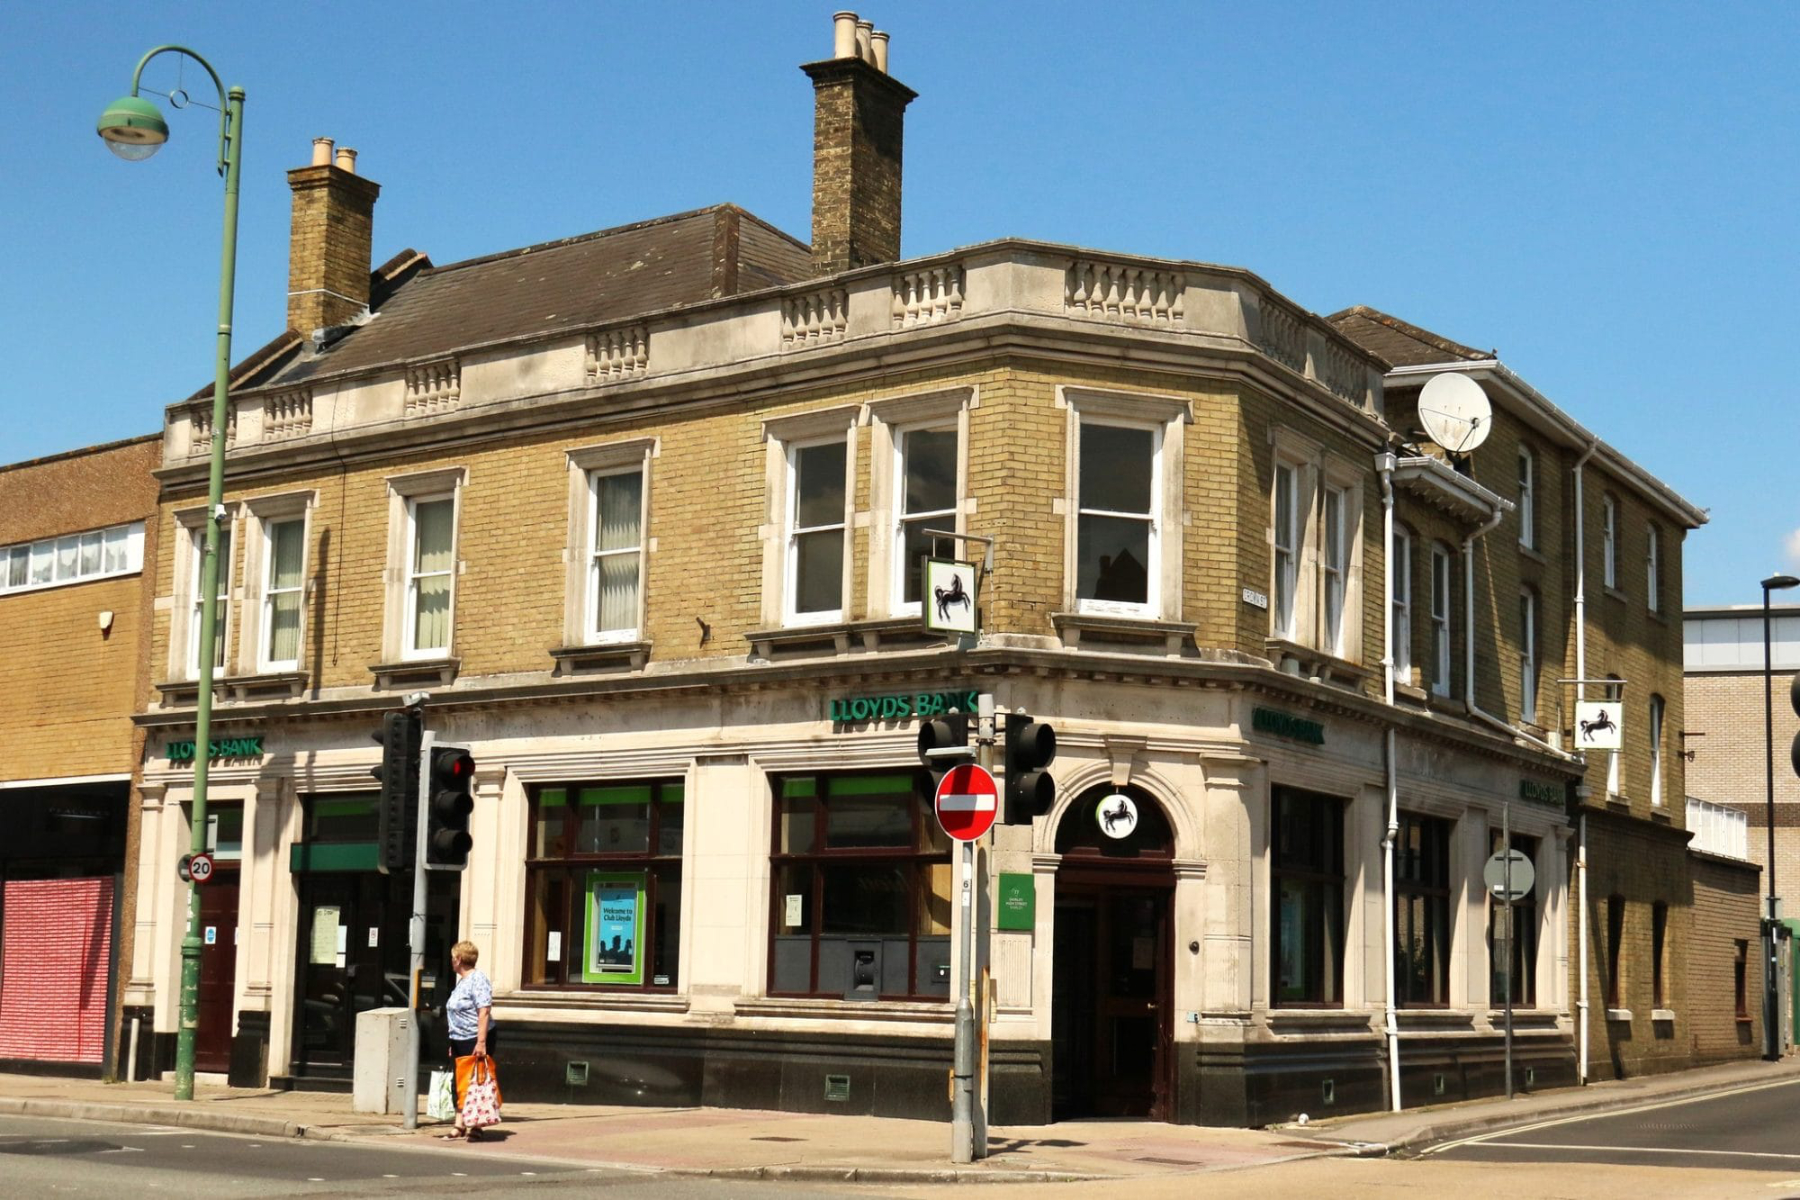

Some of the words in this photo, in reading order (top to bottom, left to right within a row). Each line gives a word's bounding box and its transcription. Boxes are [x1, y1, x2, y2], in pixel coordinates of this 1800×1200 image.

[831, 697, 911, 721] LLOYDS
[166, 742, 218, 759] LLOYS
[221, 738, 264, 756] BANK
[193, 862, 210, 874] 20
